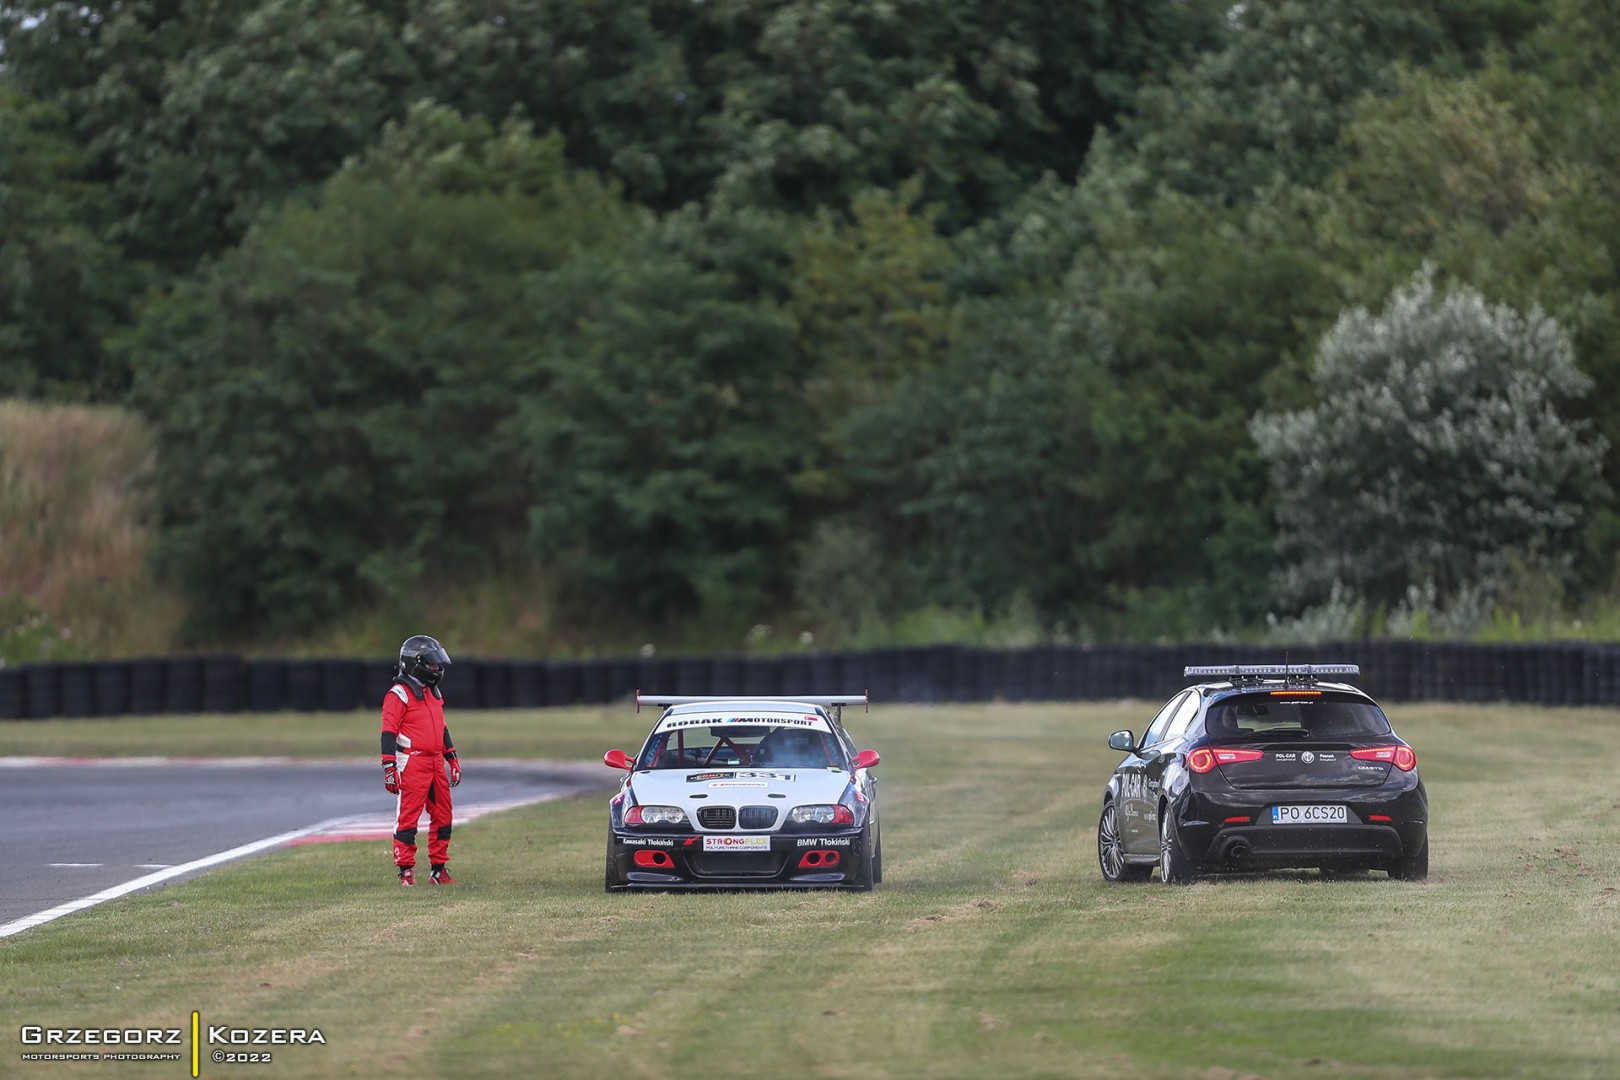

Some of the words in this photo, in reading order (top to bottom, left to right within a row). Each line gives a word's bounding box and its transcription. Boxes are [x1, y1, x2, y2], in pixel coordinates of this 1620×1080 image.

[738, 716, 813, 727] MOTORSPORT
[1280, 806, 1300, 820] PO
[1304, 806, 1345, 820] 6CS20
[706, 837, 768, 845] STRONGFLEX
[796, 838, 818, 847] BMW
